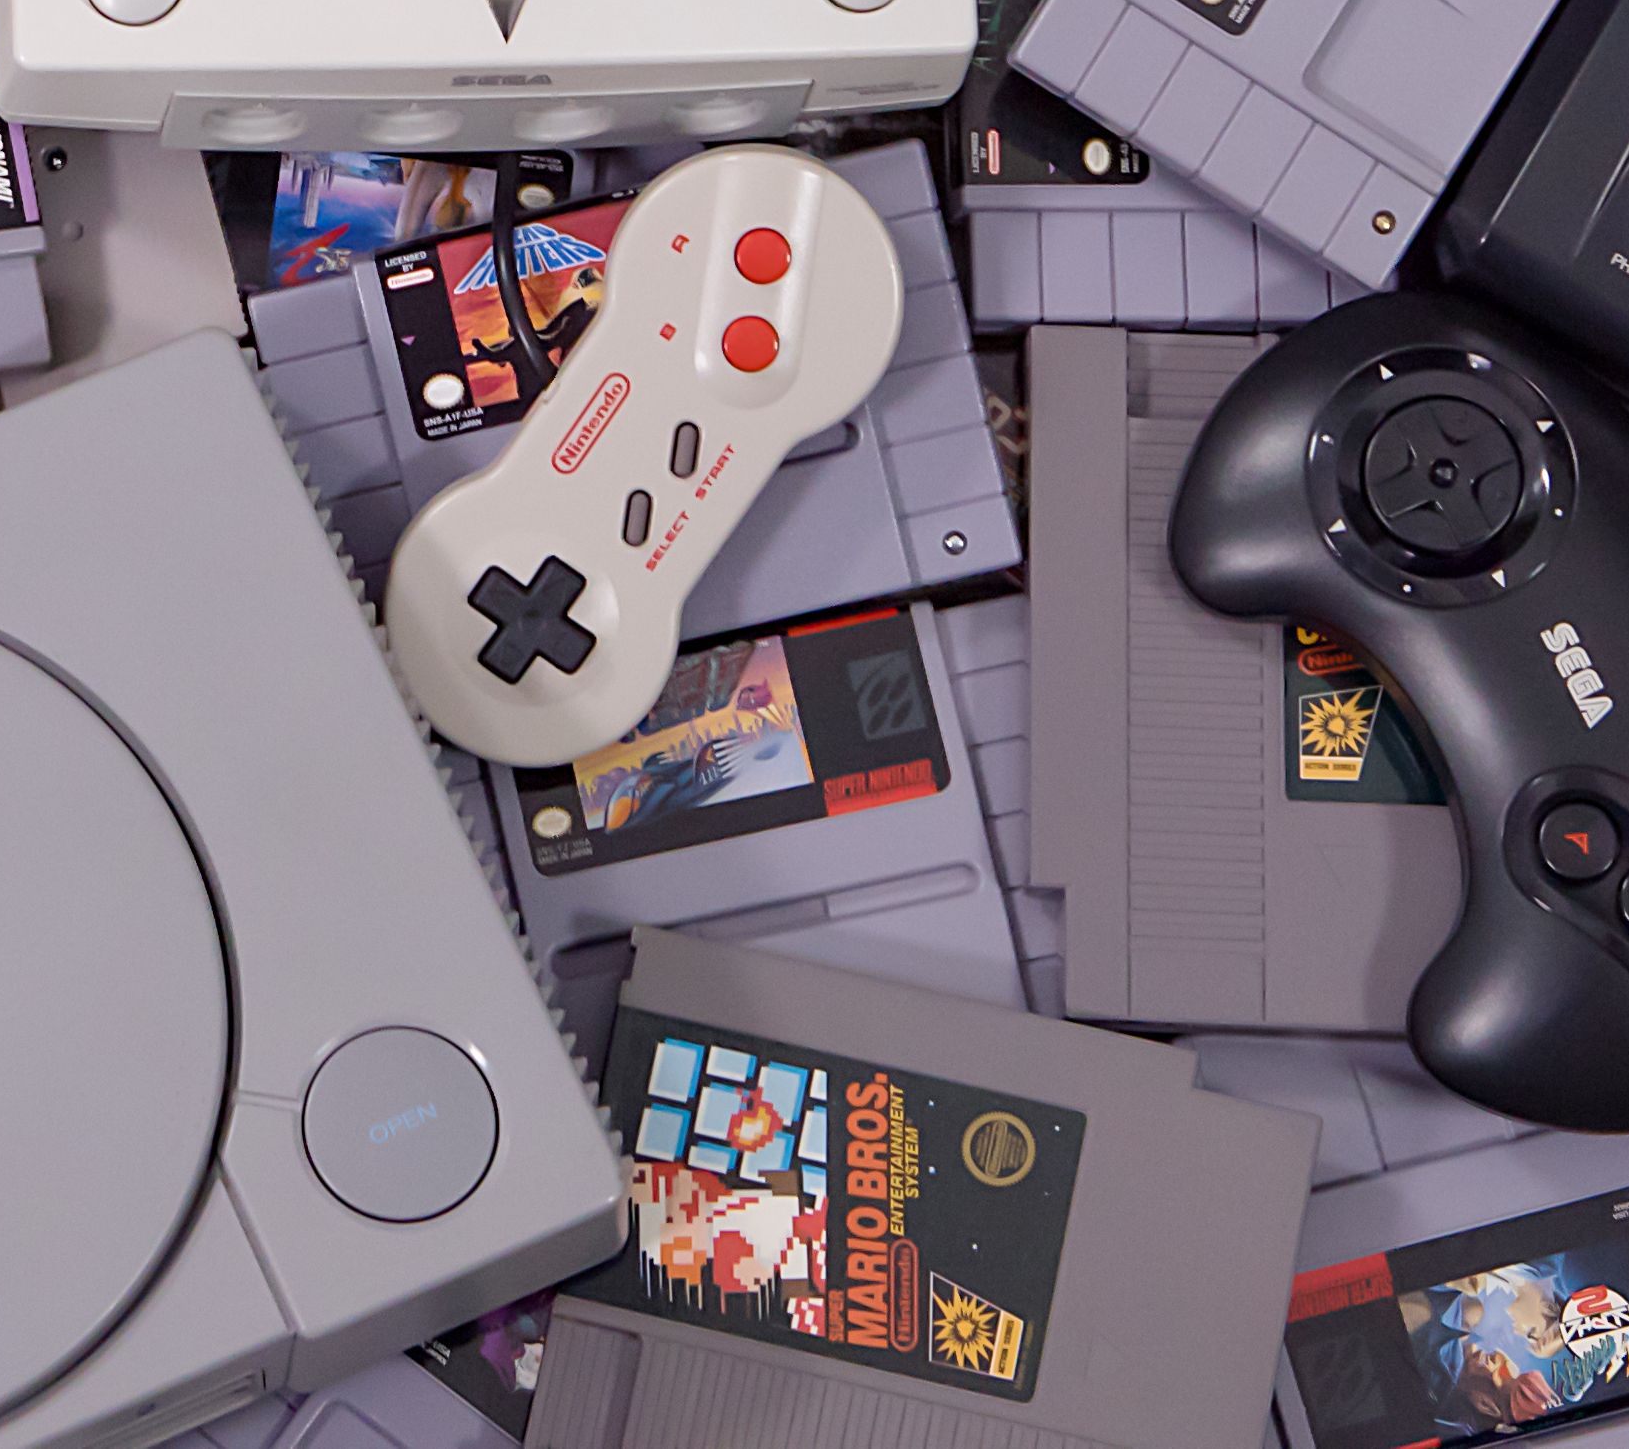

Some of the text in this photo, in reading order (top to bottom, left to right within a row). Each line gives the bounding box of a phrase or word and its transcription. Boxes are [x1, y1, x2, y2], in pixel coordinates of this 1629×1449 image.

[384, 251, 428, 267] LICENSED
[557, 380, 626, 469] Nintendo
[1547, 622, 1611, 729] SEGA
[368, 1102, 437, 1144] OPEN
[889, 1085, 904, 1237] ENTERTAINMENT
[903, 1127, 918, 1199] SYSTEM
[847, 1073, 888, 1346] MARIO BROS.
[895, 1246, 912, 1345] Nintendo
